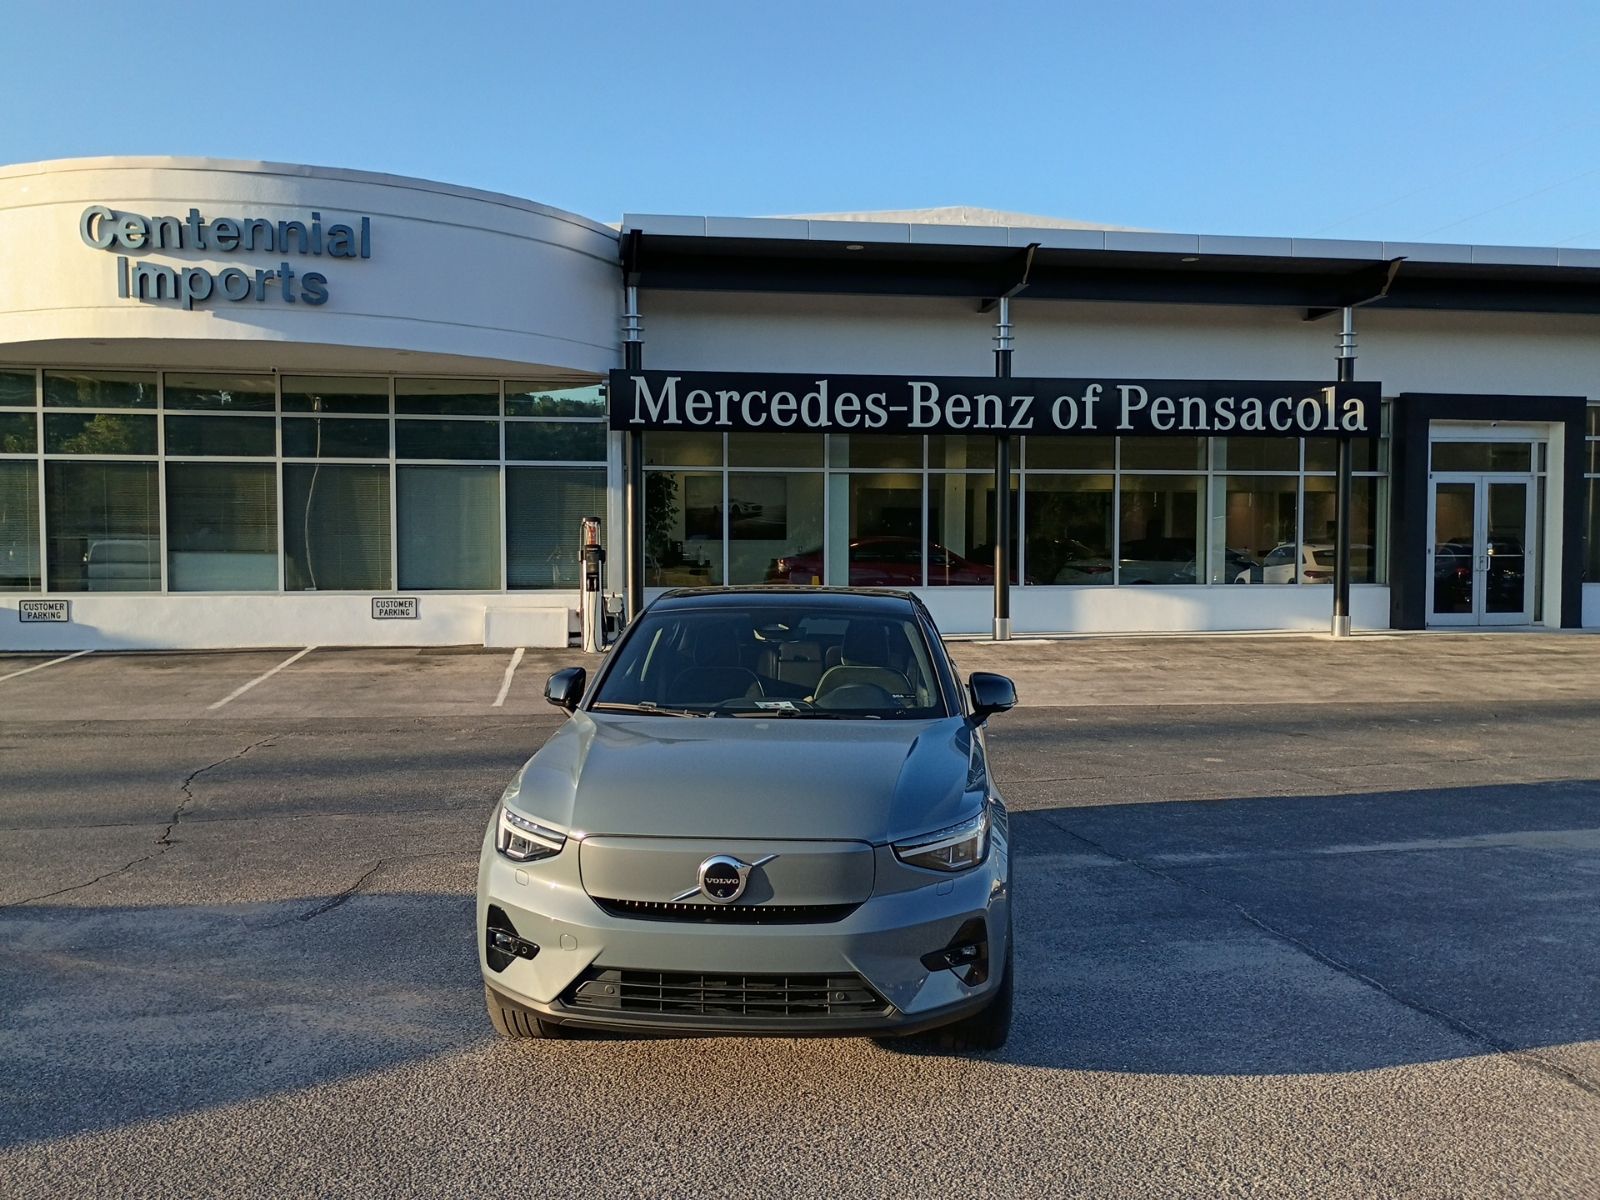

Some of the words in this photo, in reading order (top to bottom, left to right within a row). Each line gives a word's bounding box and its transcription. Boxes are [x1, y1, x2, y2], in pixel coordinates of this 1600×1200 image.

[79, 204, 371, 259] Centennial
[117, 256, 329, 311] Imports
[629, 375, 1035, 429] Mercedes-Benz
[1051, 383, 1103, 430] of
[1116, 384, 1368, 431] Pensacola
[23, 602, 65, 611] CUSTOMER
[375, 600, 414, 608] CUSTOMER
[27, 611, 62, 619] PARKING
[379, 608, 410, 616] PARKING
